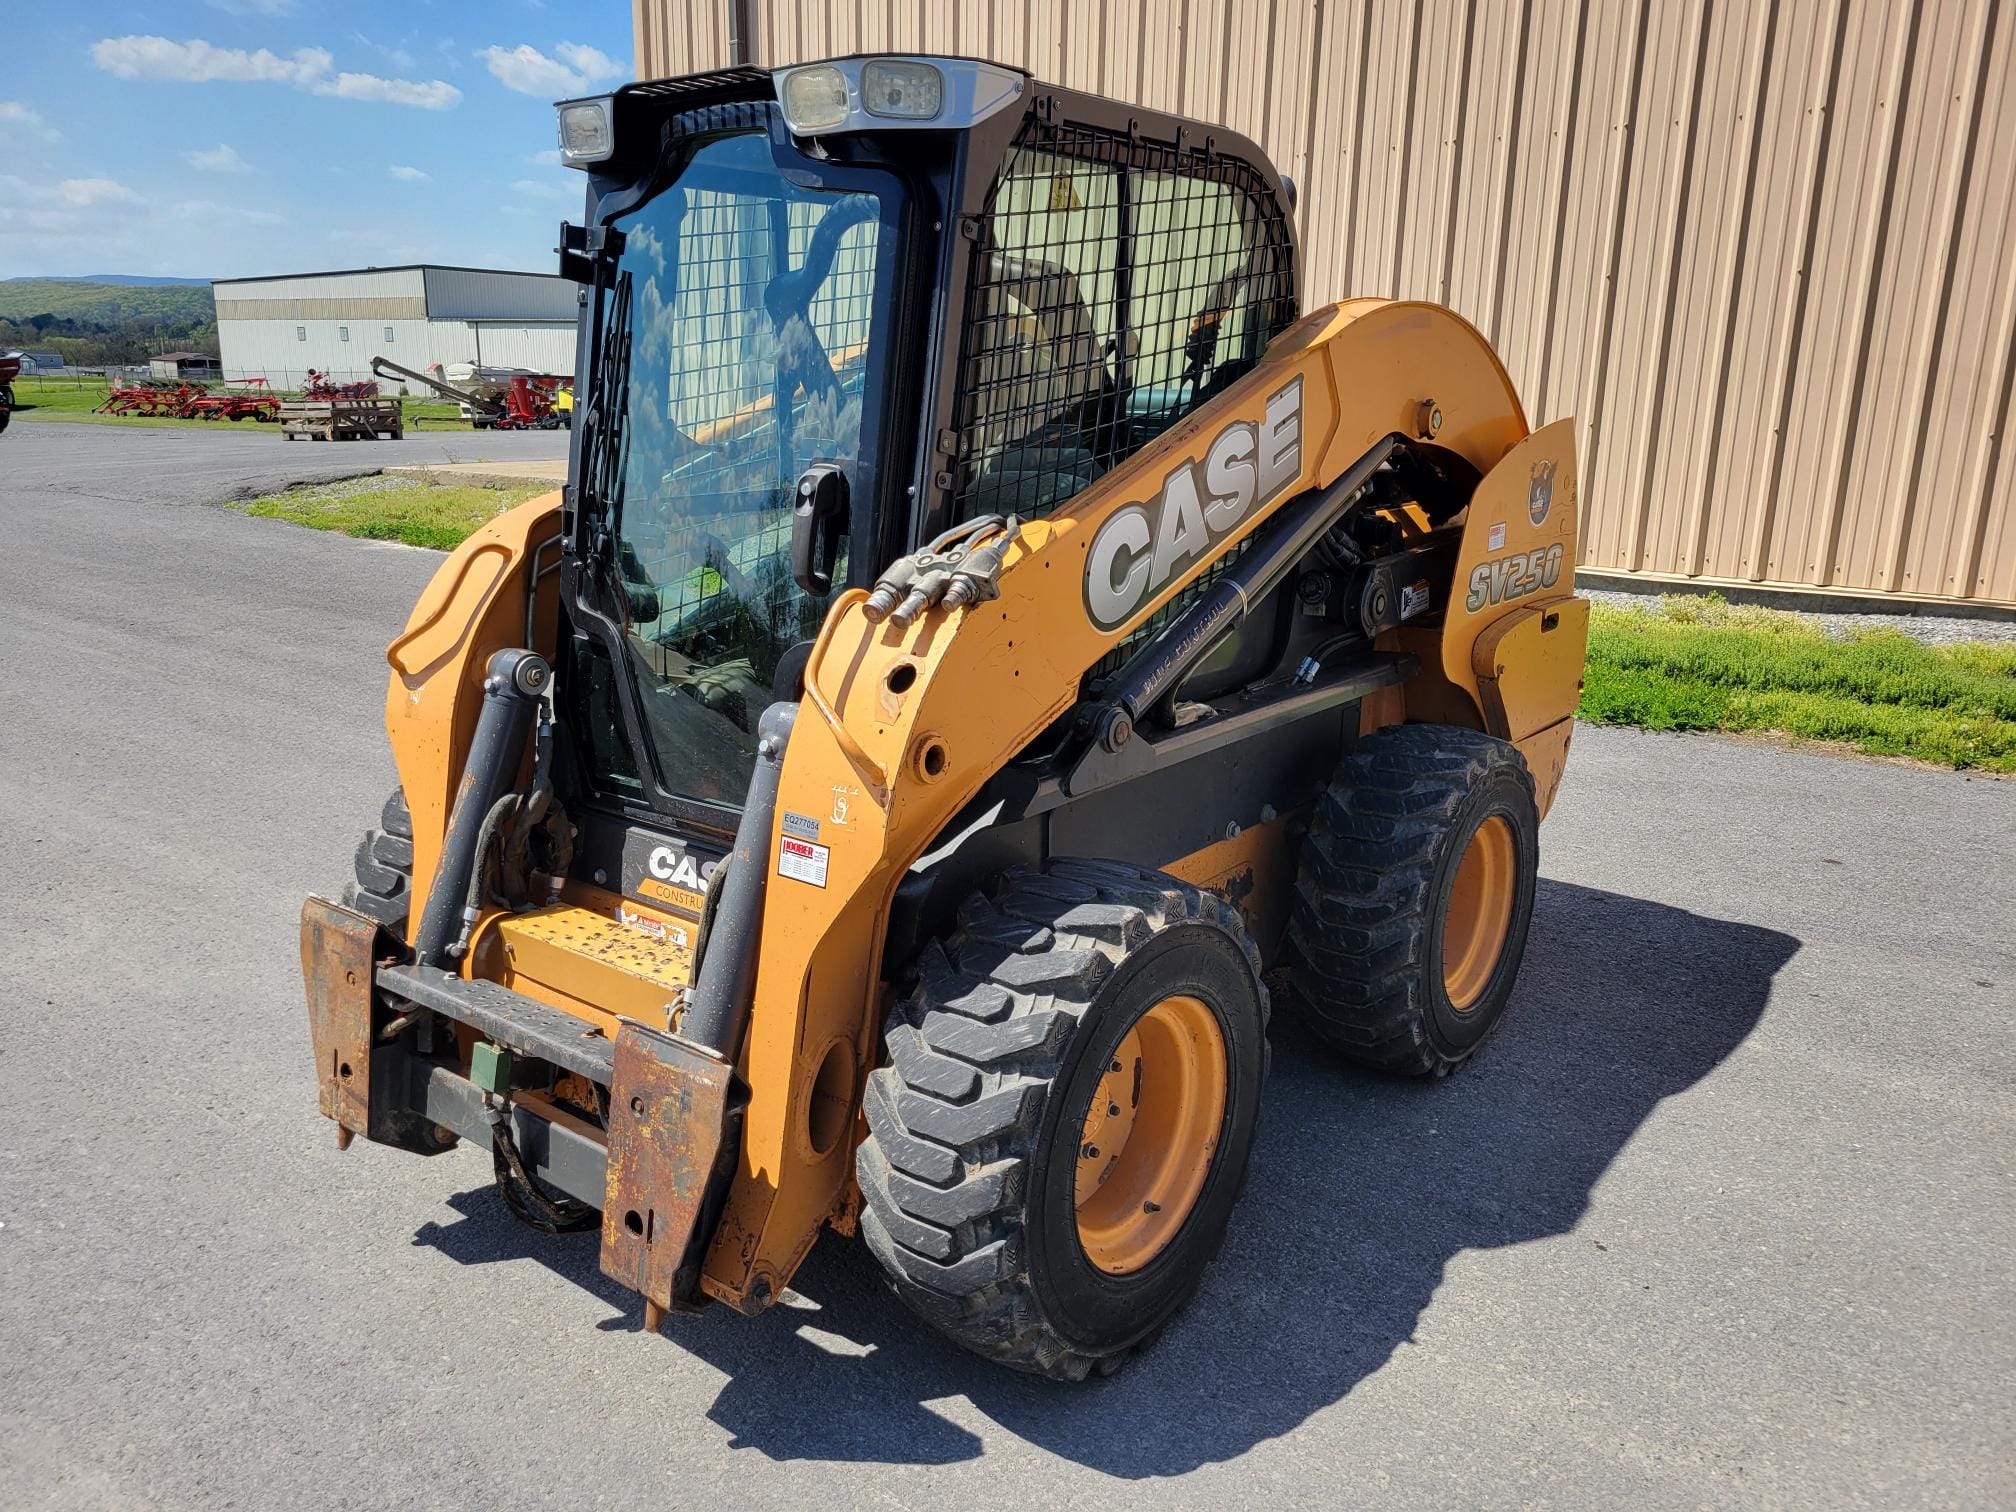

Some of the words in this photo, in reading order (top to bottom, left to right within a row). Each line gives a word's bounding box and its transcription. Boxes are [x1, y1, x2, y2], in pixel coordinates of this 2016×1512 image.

[1085, 378, 1302, 629] CASE
[1466, 543, 1564, 613] SV250
[784, 813, 819, 830] EQ277054
